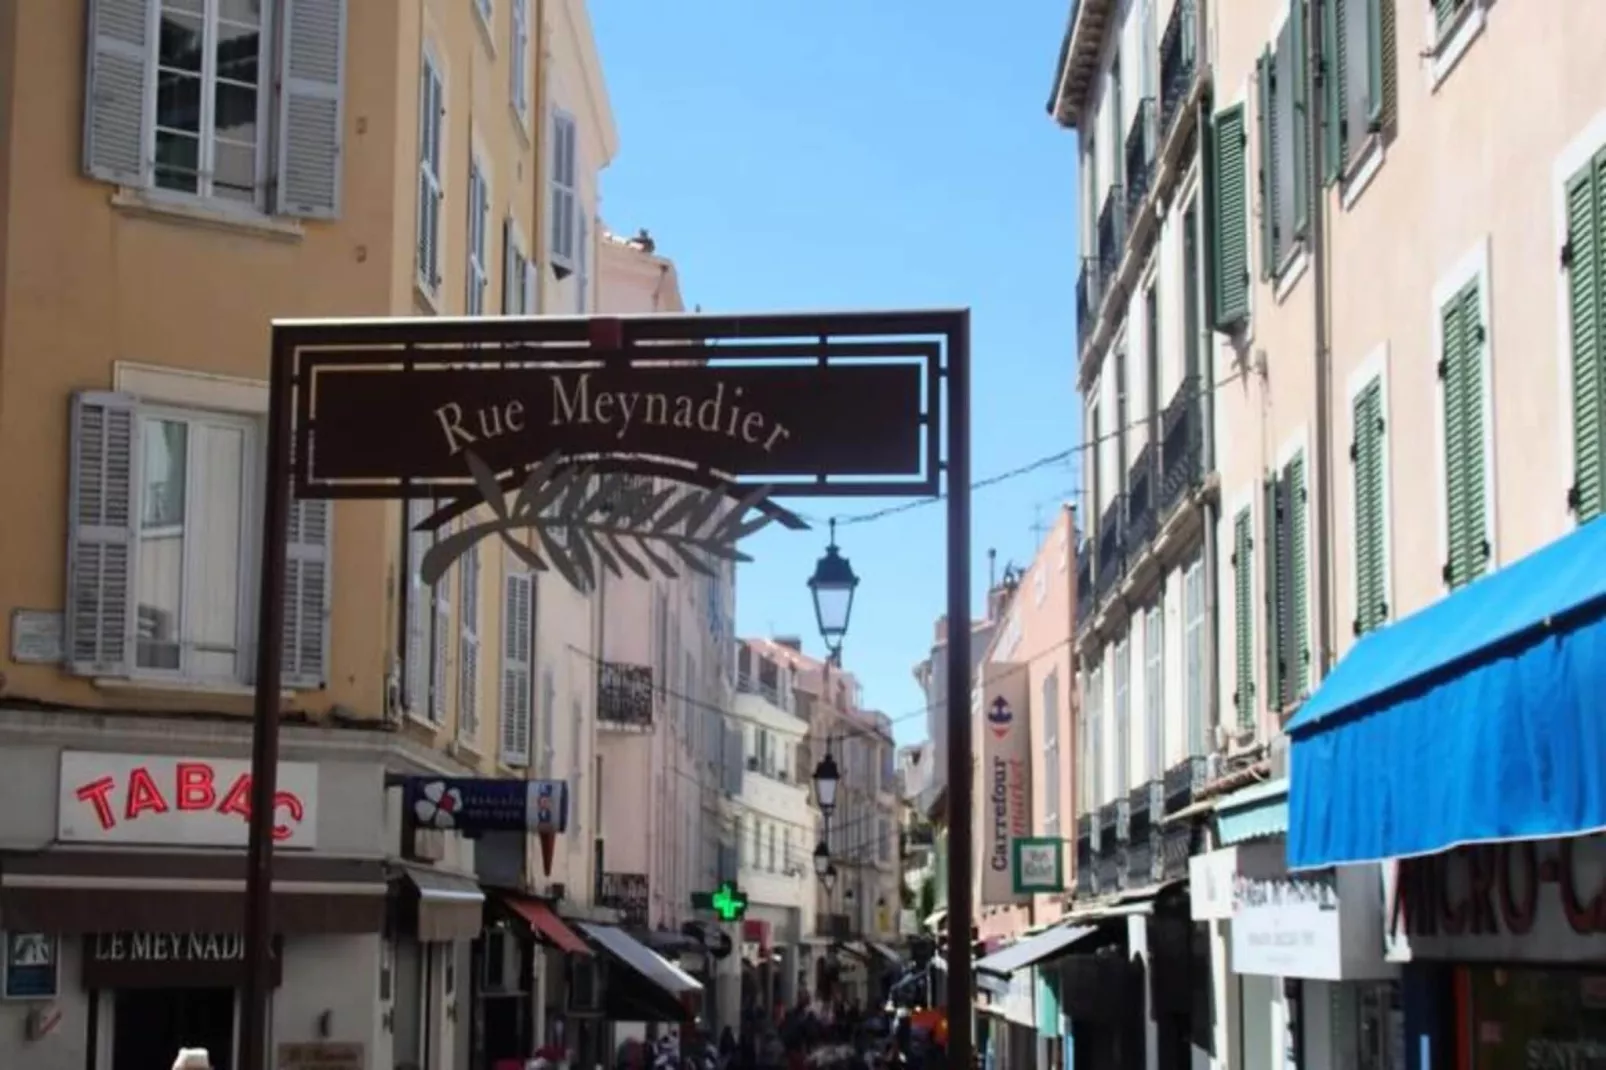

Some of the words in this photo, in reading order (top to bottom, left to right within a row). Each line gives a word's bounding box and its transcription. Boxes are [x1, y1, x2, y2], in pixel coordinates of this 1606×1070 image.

[434, 397, 525, 457] Rue
[548, 372, 791, 452] Meynadier
[76, 762, 304, 841] TABAC
[991, 755, 1008, 872] Carrefour
[95, 932, 125, 961] LE
